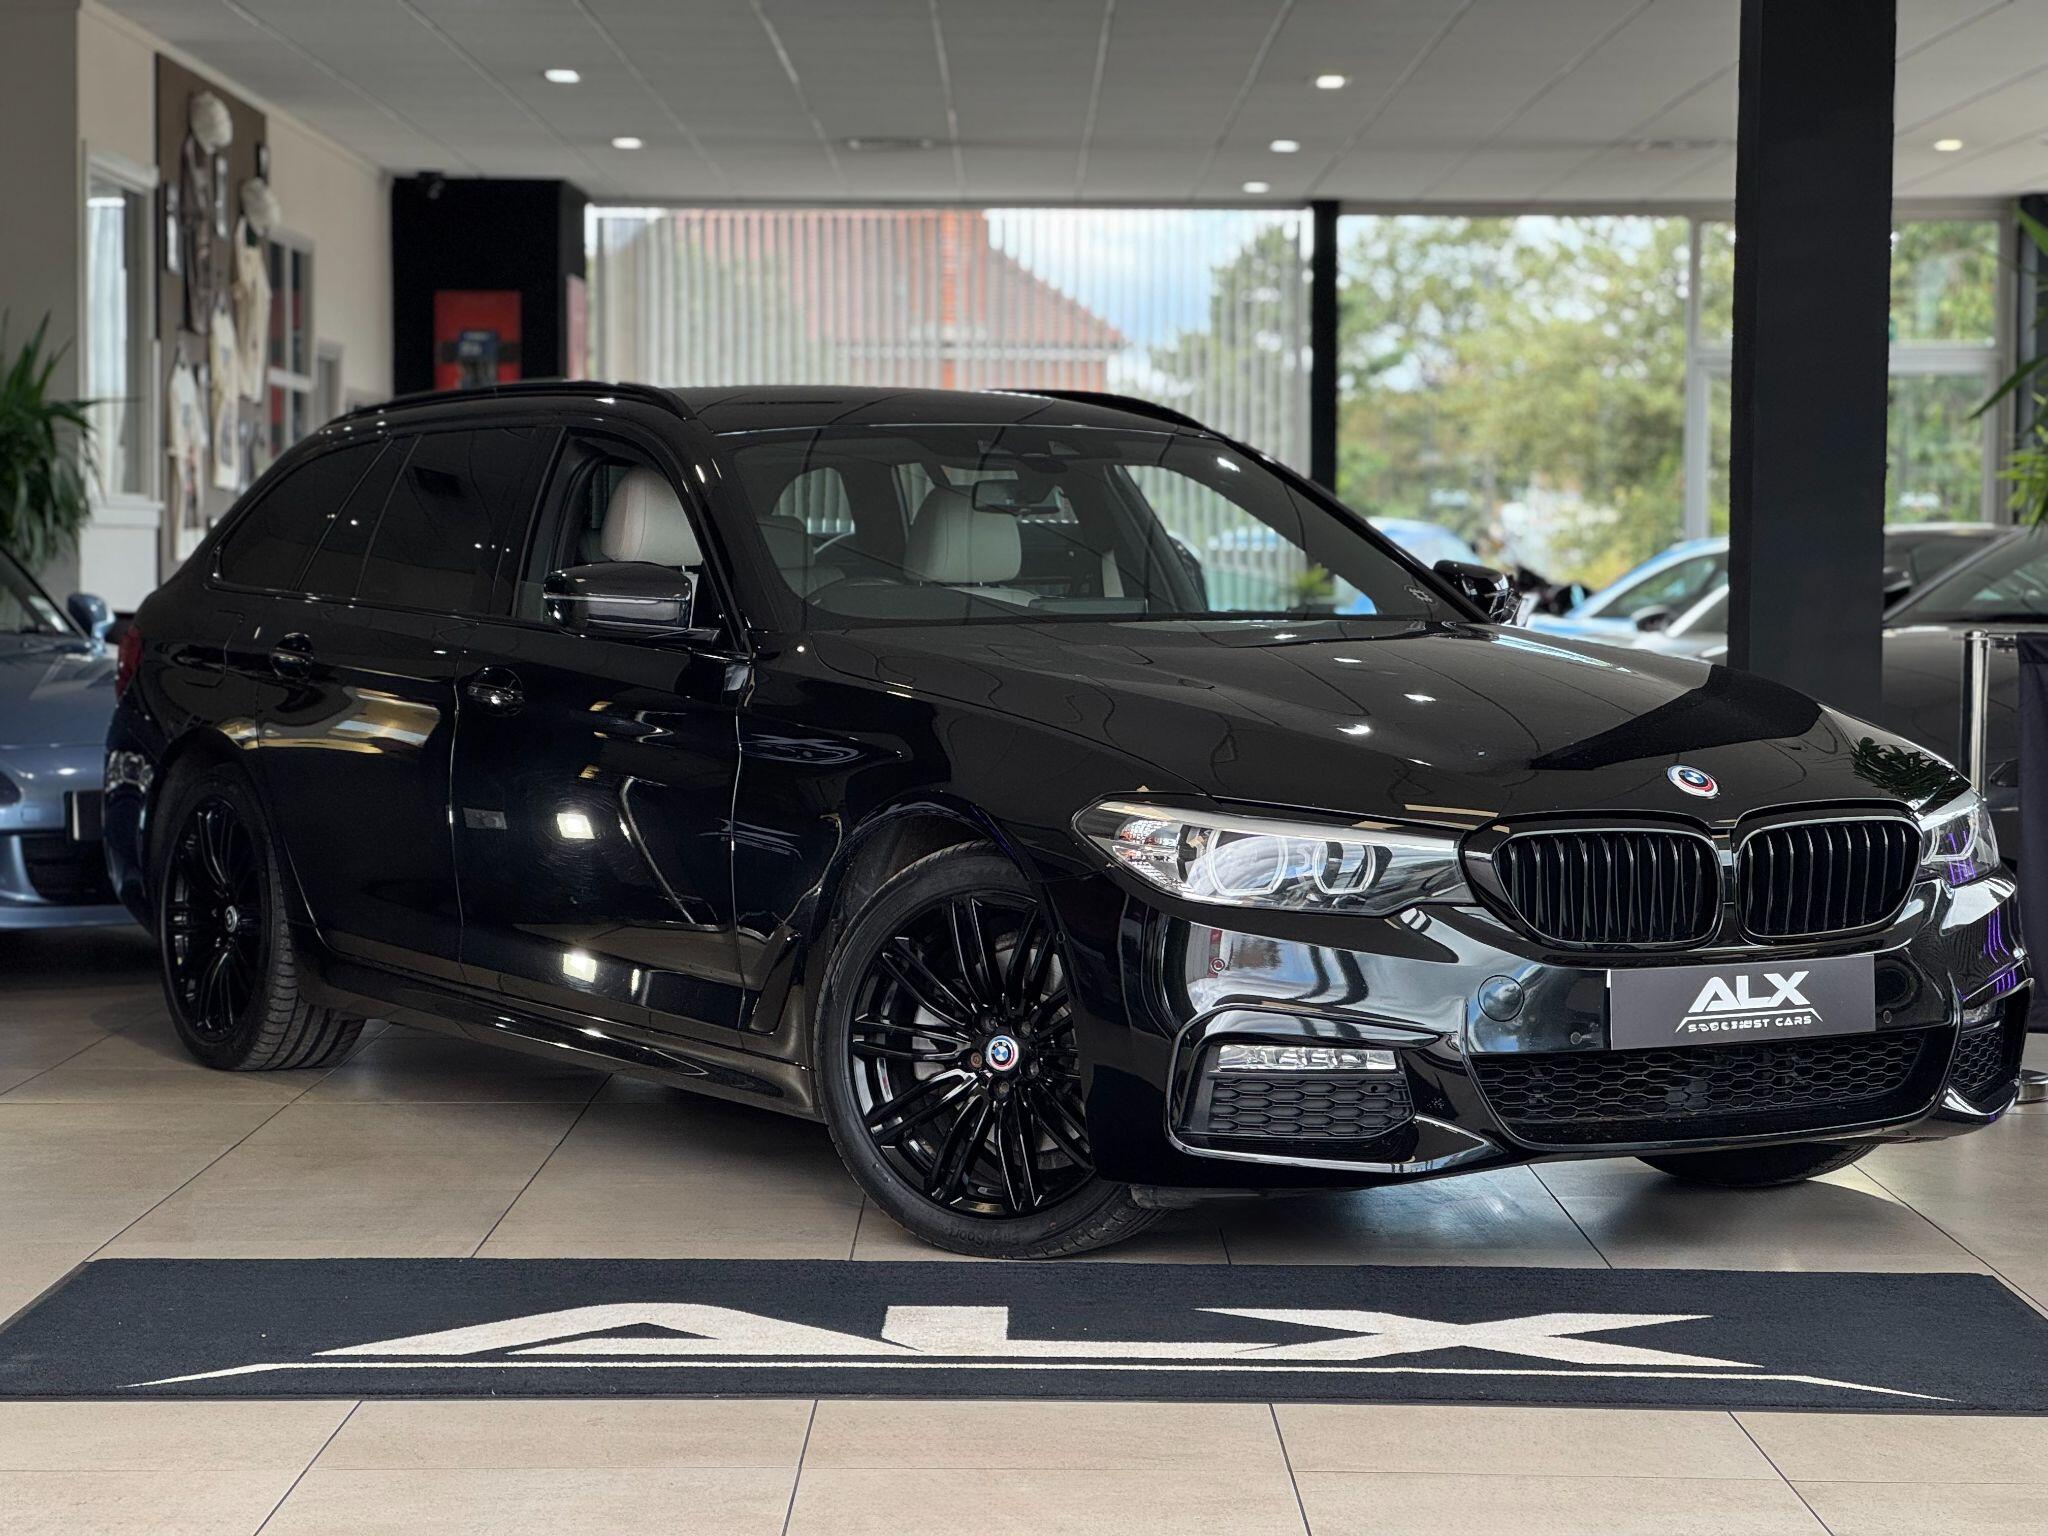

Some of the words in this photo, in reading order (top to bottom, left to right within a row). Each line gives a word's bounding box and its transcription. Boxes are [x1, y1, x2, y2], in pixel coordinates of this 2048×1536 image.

[1688, 970, 1811, 1014] ALX
[1775, 1015, 1812, 1027] CARS
[311, 1302, 1764, 1368] ALX
